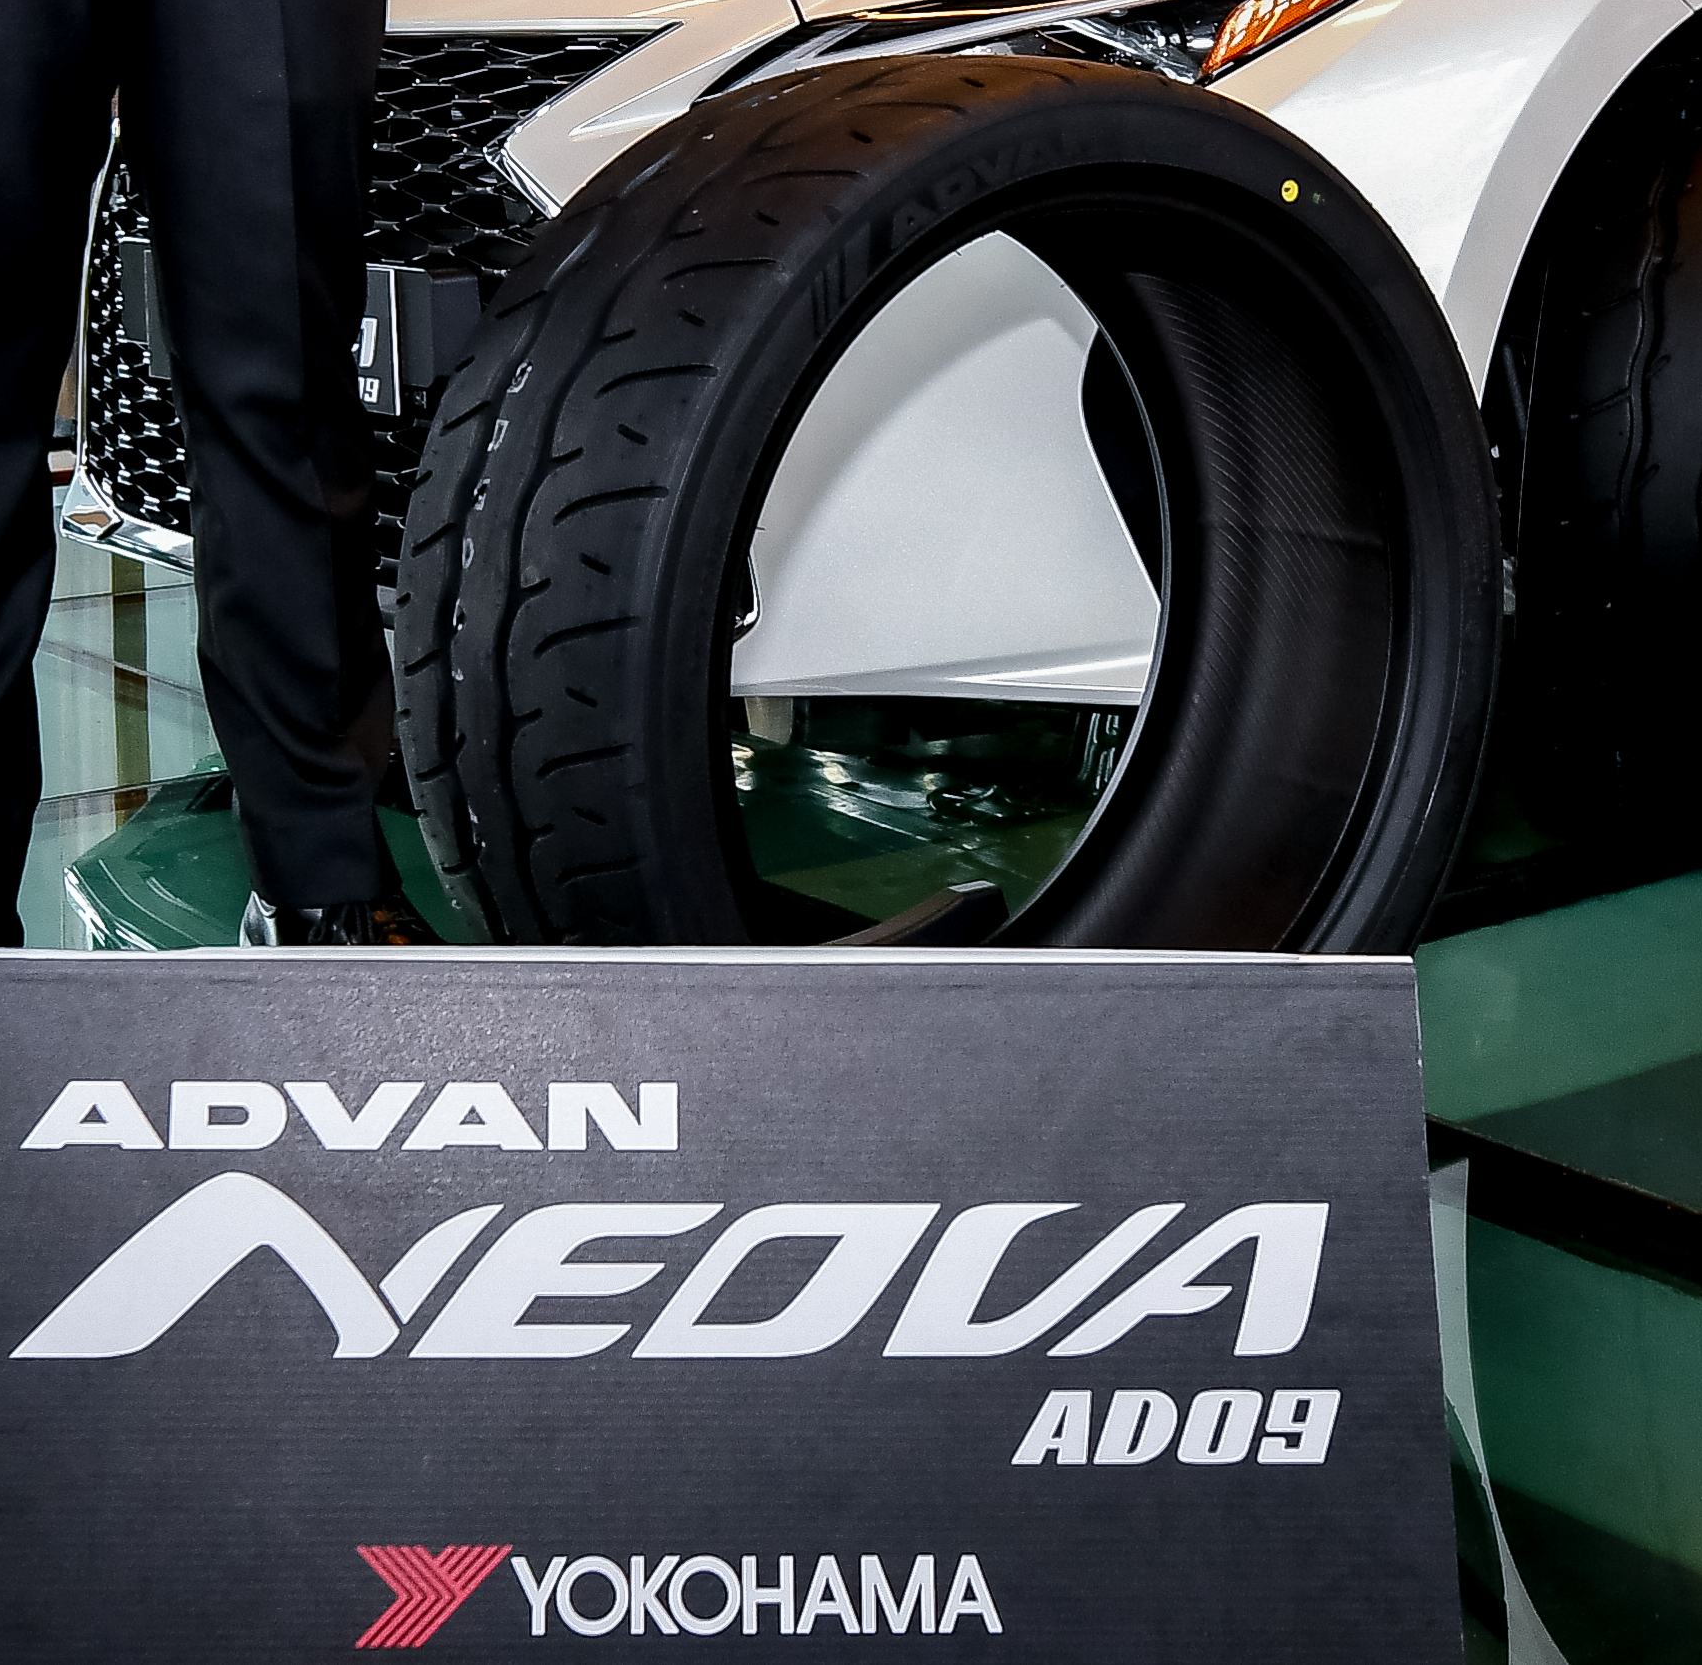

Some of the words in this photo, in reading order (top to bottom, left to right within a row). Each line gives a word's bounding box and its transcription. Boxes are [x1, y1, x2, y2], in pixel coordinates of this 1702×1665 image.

[20, 1079, 679, 1151] ADVAN
[9, 1171, 1330, 1359] NEOVA
[1011, 1389, 1341, 1465] AD09
[510, 1554, 1003, 1636] YOKOHAMA
